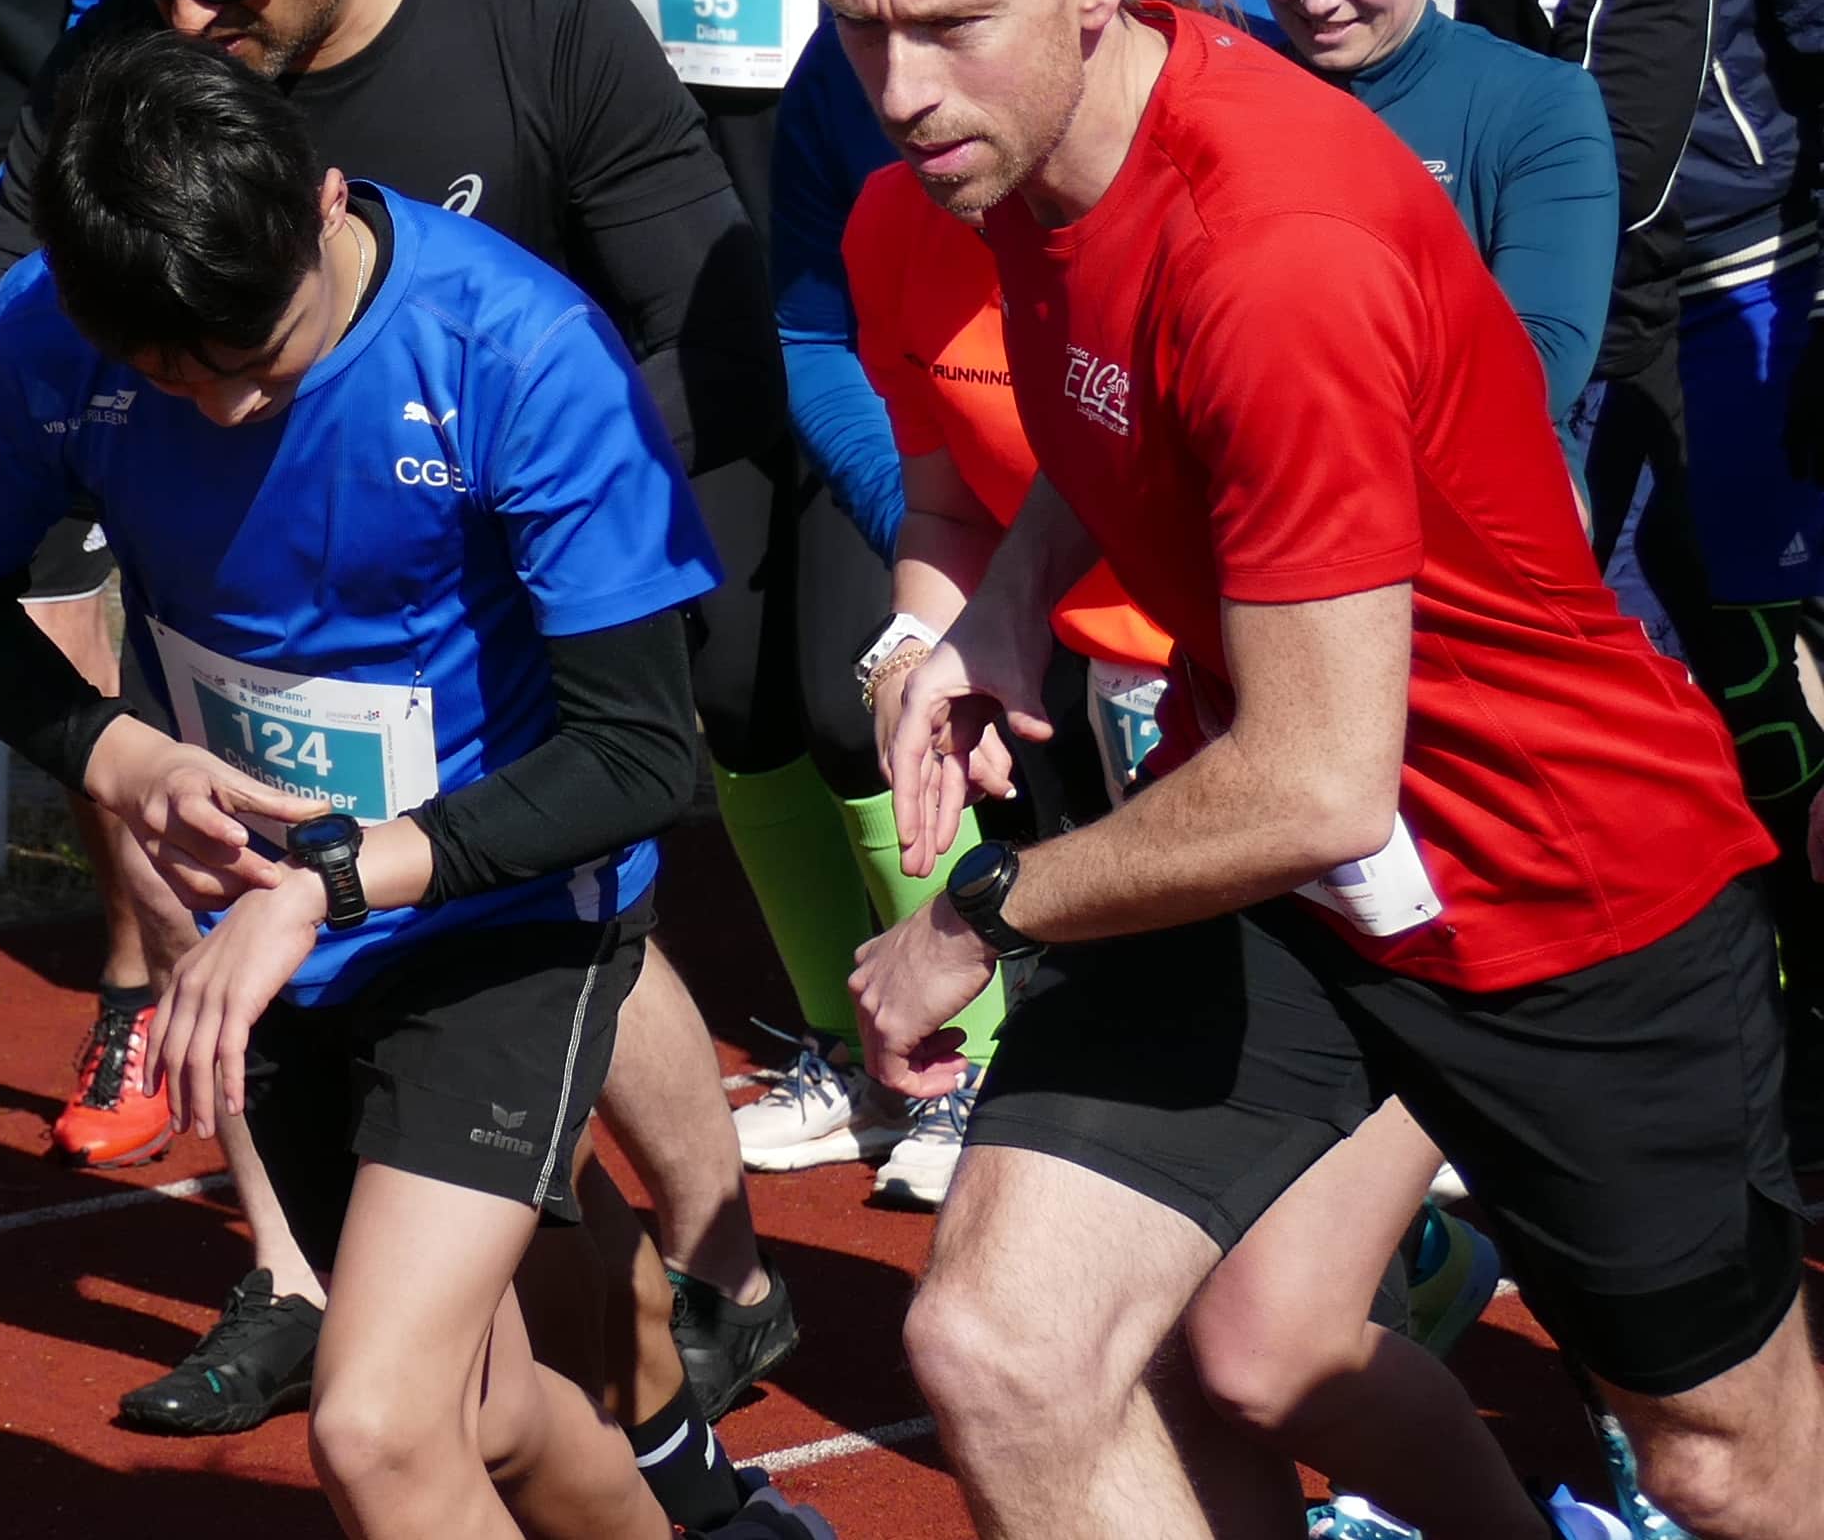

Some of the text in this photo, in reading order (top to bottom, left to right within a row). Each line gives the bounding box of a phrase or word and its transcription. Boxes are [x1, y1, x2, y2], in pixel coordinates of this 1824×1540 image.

[695, 23, 738, 43] Diana
[395, 456, 467, 493] CGE
[238, 677, 248, 689] 5
[238, 691, 248, 703] &
[251, 694, 312, 720] Firmenlauf
[232, 712, 333, 777] 124
[225, 747, 358, 811] Christopher
[470, 1127, 535, 1156] erima
